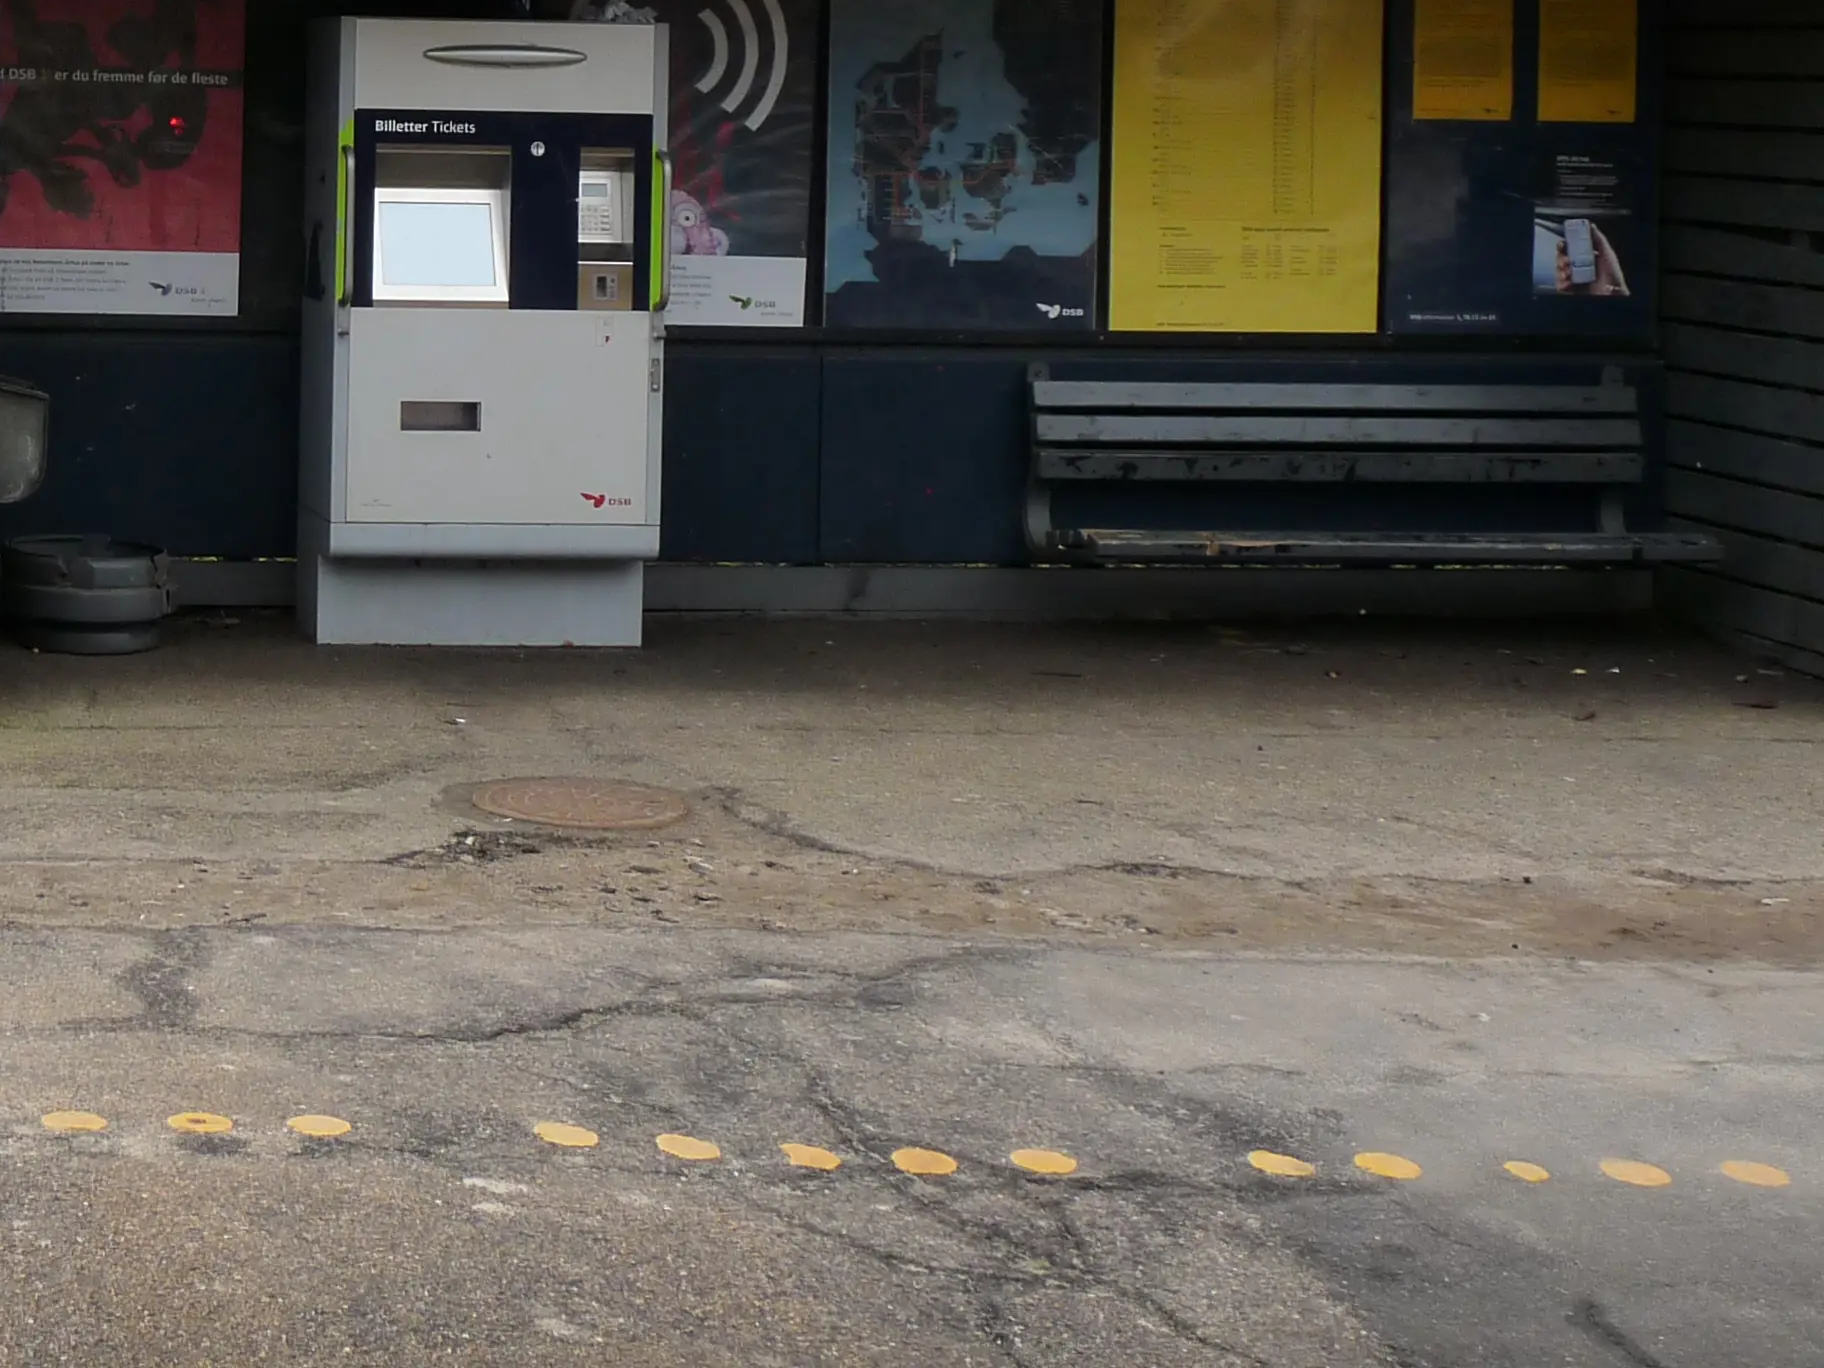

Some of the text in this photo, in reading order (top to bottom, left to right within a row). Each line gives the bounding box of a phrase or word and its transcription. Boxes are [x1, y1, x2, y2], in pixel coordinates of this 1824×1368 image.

[8, 67, 37, 81] DSB
[54, 69, 70, 82] er
[72, 68, 90, 82] du
[92, 68, 144, 83] fremme
[171, 70, 189, 84] de
[191, 71, 229, 86] fleste
[374, 119, 476, 134] Billetter Tickets
[1062, 308, 1084, 317] DSB
[608, 497, 632, 507] DSB
